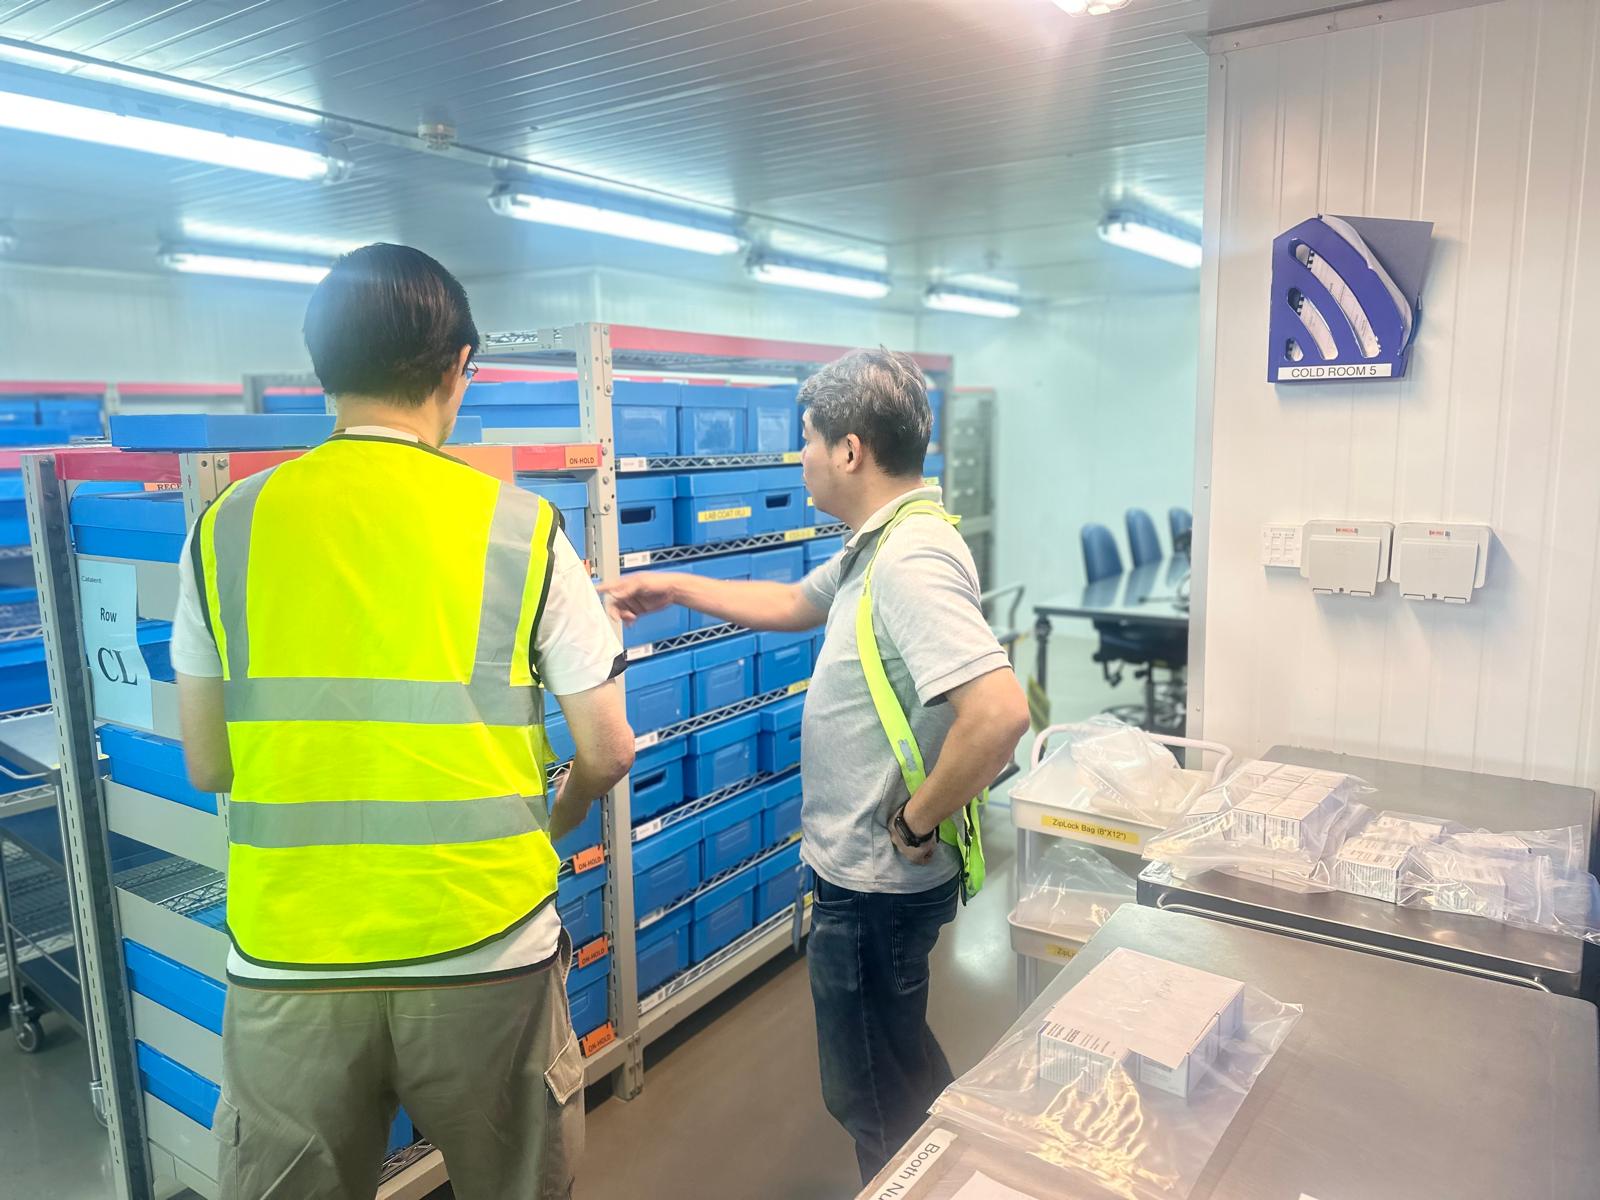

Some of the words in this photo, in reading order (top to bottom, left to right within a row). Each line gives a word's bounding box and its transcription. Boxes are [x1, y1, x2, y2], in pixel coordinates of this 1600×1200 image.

[1291, 368, 1325, 378] COLD
[1328, 366, 1366, 377] ROOM
[1369, 366, 1377, 376] 5
[569, 457, 595, 465] ON-HOLD
[100, 607, 117, 623] Row
[97, 647, 138, 686] CL
[1052, 818, 1079, 830] ZipLock
[1081, 824, 1096, 834] Bag
[578, 856, 602, 870] ON-HOLD
[581, 947, 605, 965] ON-HOLD
[588, 1033, 612, 1052] ON-HOLD
[898, 1142, 942, 1180] Booth
